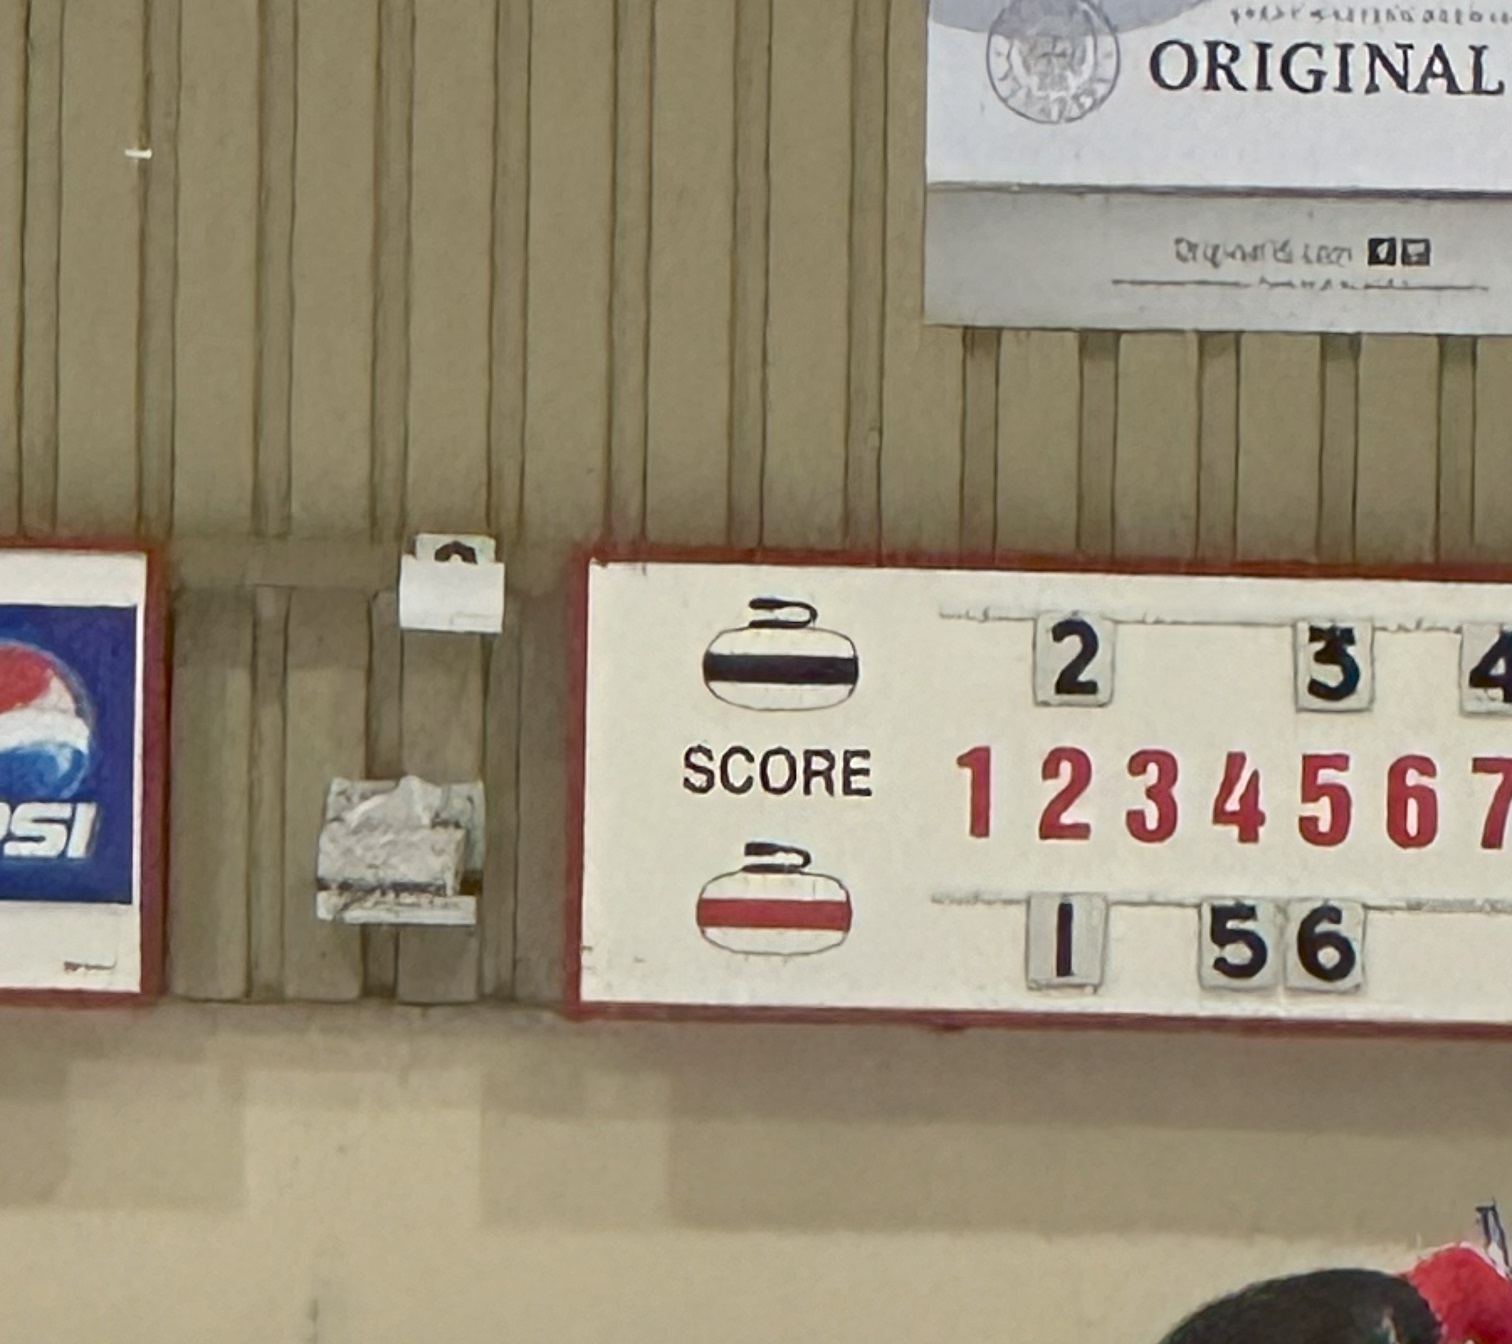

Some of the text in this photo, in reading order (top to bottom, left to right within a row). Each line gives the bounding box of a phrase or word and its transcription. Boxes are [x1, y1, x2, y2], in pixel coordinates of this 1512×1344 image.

[1149, 39, 1505, 96] ORIGINAL
[1051, 619, 1099, 696] 2
[1307, 624, 1361, 702] 3
[683, 744, 873, 797] SCORE
[955, 746, 990, 837] 1
[1039, 747, 1091, 840] 2
[1126, 749, 1177, 843] 3
[1212, 753, 1264, 843] 4
[1298, 753, 1351, 847] 5
[1386, 756, 1437, 849] 6
[1056, 901, 1356, 982] 1 5 6
